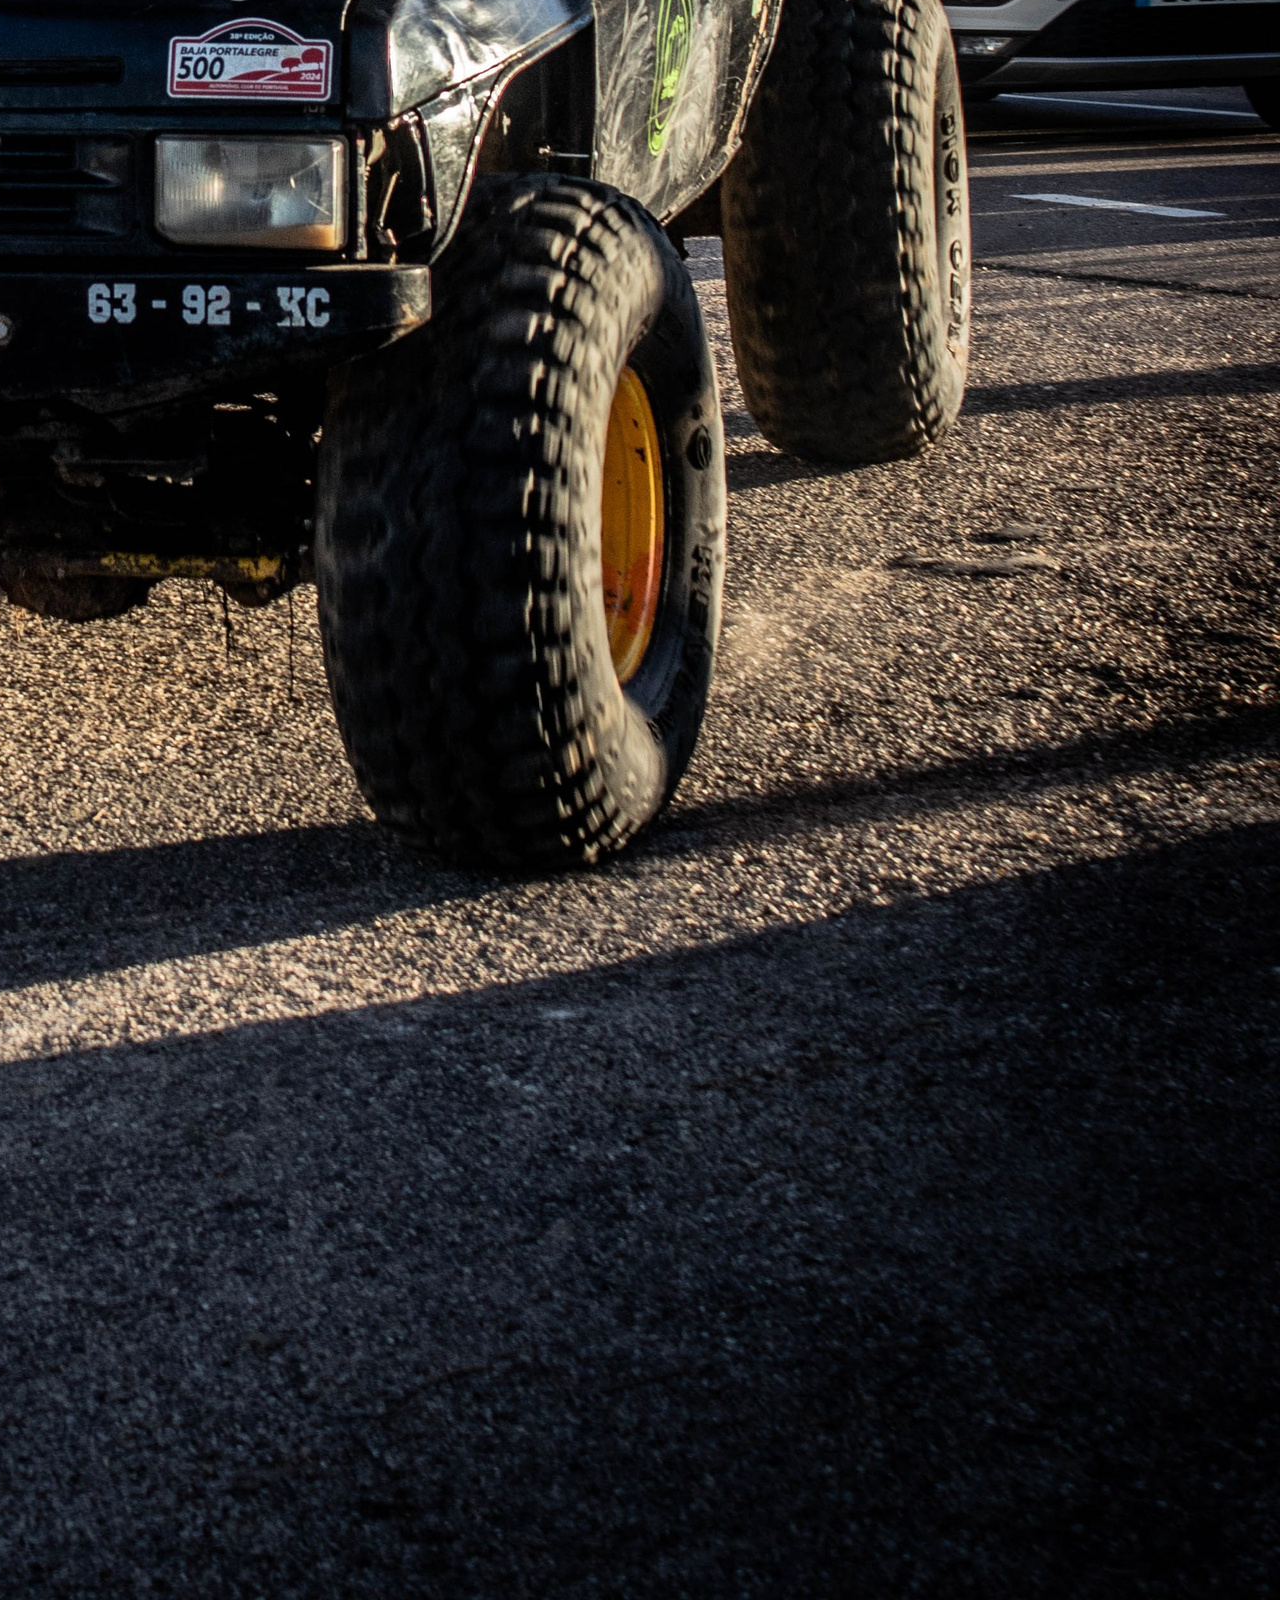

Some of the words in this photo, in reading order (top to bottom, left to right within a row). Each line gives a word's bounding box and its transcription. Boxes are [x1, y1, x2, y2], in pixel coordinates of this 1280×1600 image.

[244, 32, 275, 42] EDIÇÃO
[180, 46, 207, 55] BAJA
[209, 46, 280, 58] PORTALEGRE
[177, 56, 225, 80] 500
[300, 72, 321, 80] 2024
[88, 283, 136, 323] 63
[182, 285, 231, 325] 92
